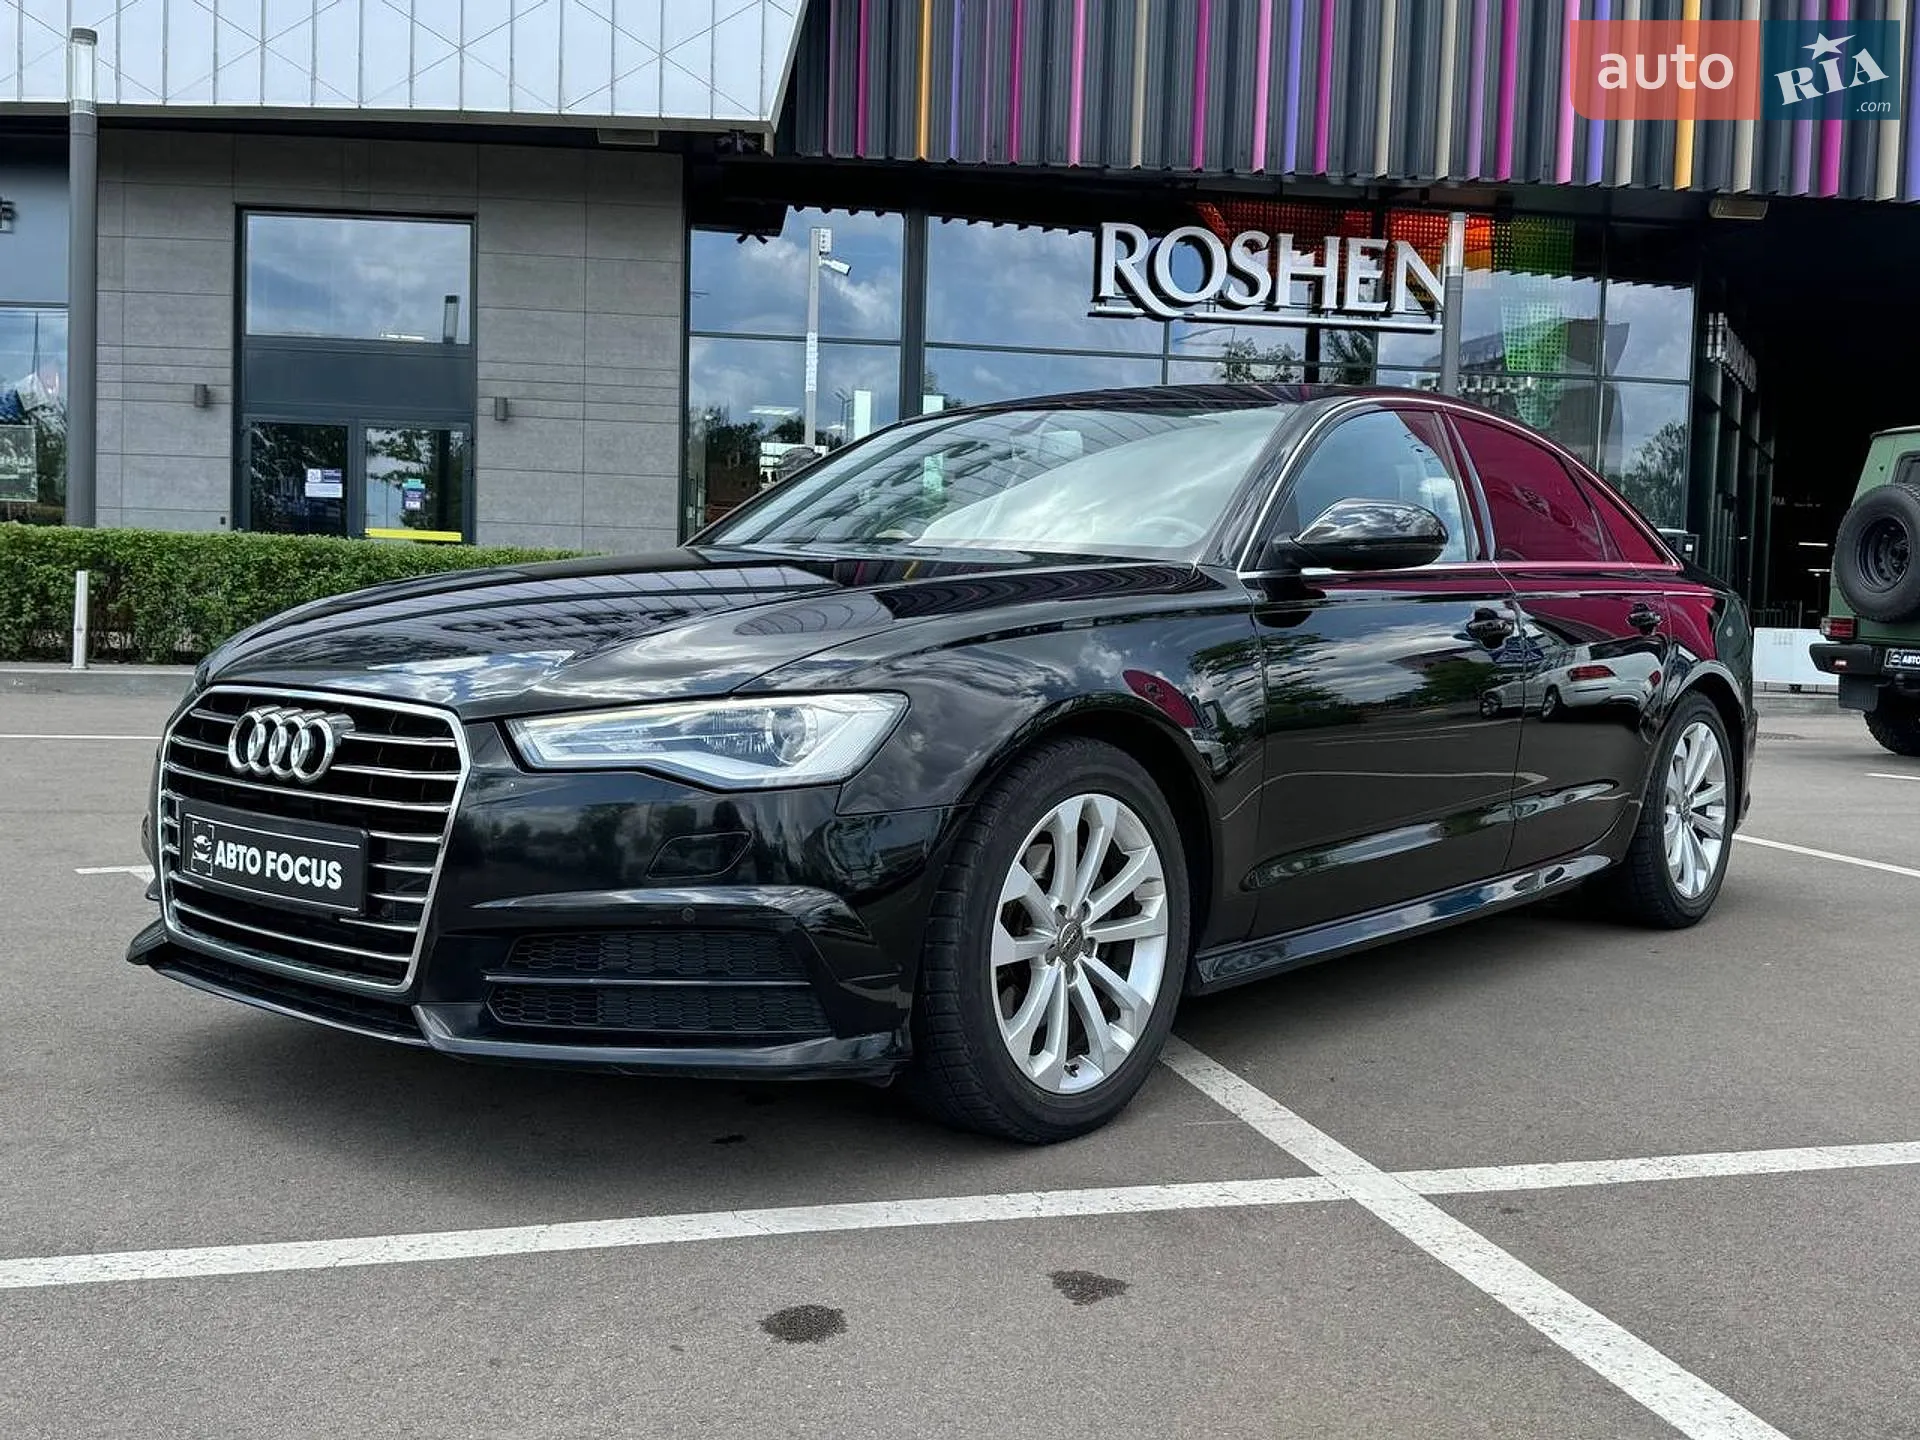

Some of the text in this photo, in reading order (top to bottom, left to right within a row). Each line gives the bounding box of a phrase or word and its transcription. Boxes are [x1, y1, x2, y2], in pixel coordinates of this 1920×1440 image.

[1099, 222, 1447, 317] ROSHEN
[214, 840, 343, 890] АВТО FOCUS
